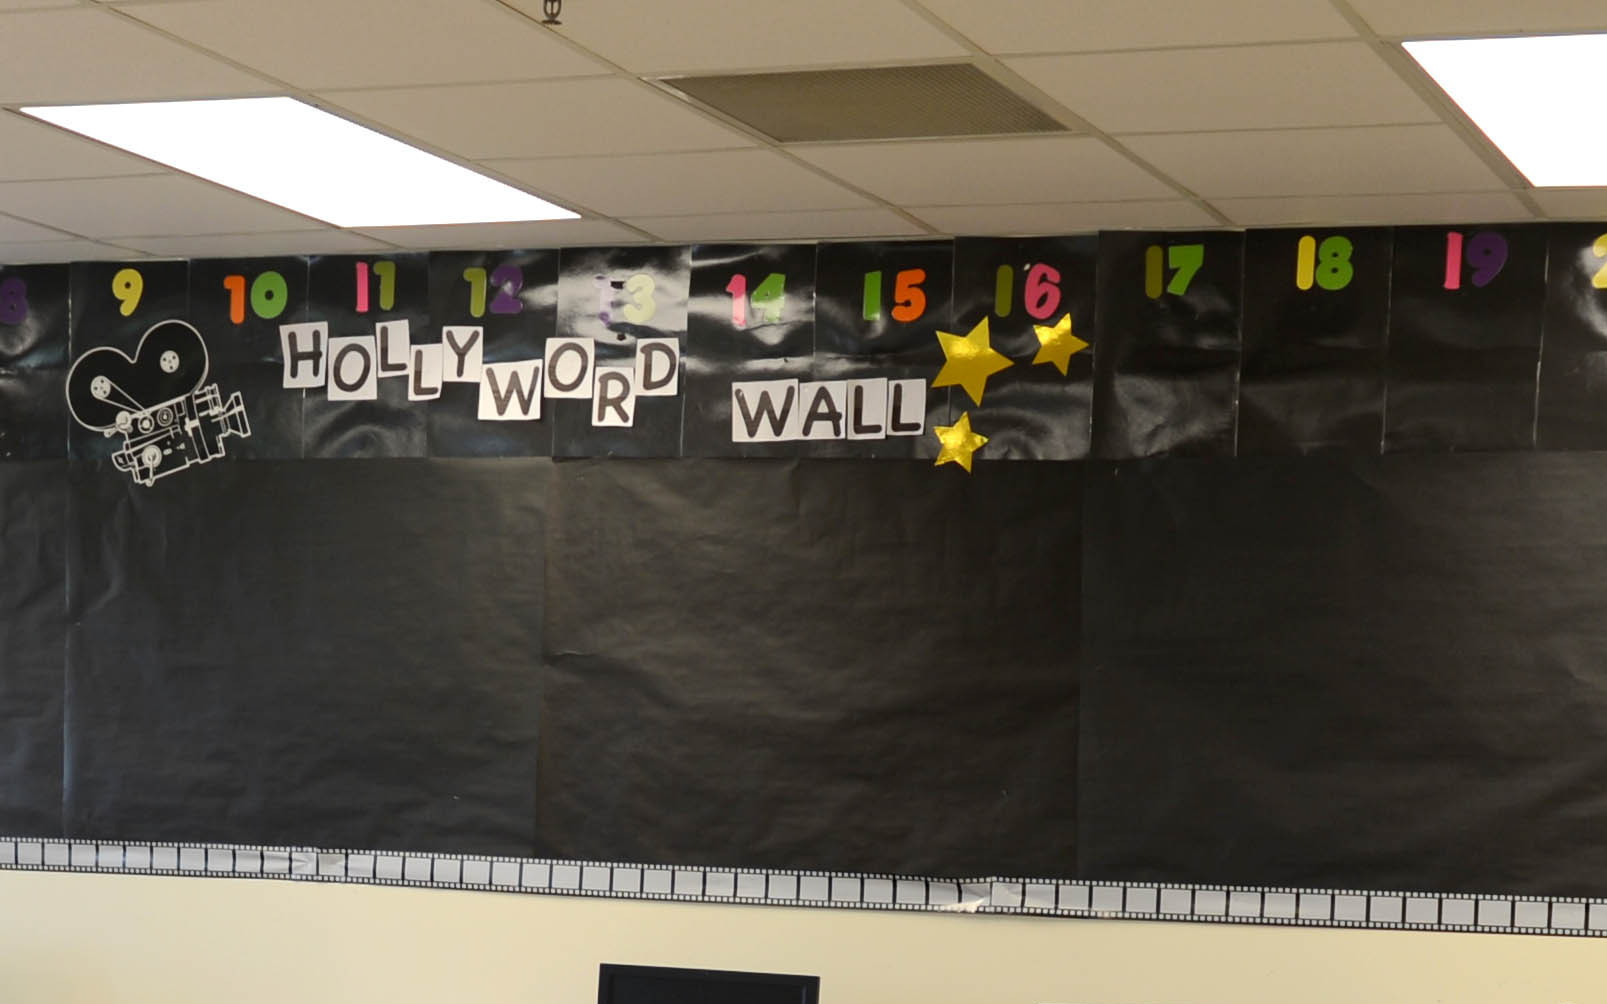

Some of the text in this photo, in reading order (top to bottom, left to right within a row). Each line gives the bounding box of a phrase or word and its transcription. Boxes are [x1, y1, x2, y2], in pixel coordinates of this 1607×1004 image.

[355, 261, 396, 312] 11
[1145, 244, 1204, 299] 17
[1297, 235, 1354, 291] 18
[1444, 231, 1508, 290] 19
[112, 268, 144, 316] 9
[224, 271, 288, 324] 10
[463, 265, 524, 318] 12
[725, 273, 786, 328] 14
[863, 269, 927, 322] 15
[995, 263, 1062, 319] 16
[287, 326, 921, 438] HOLLYWORD WALL
